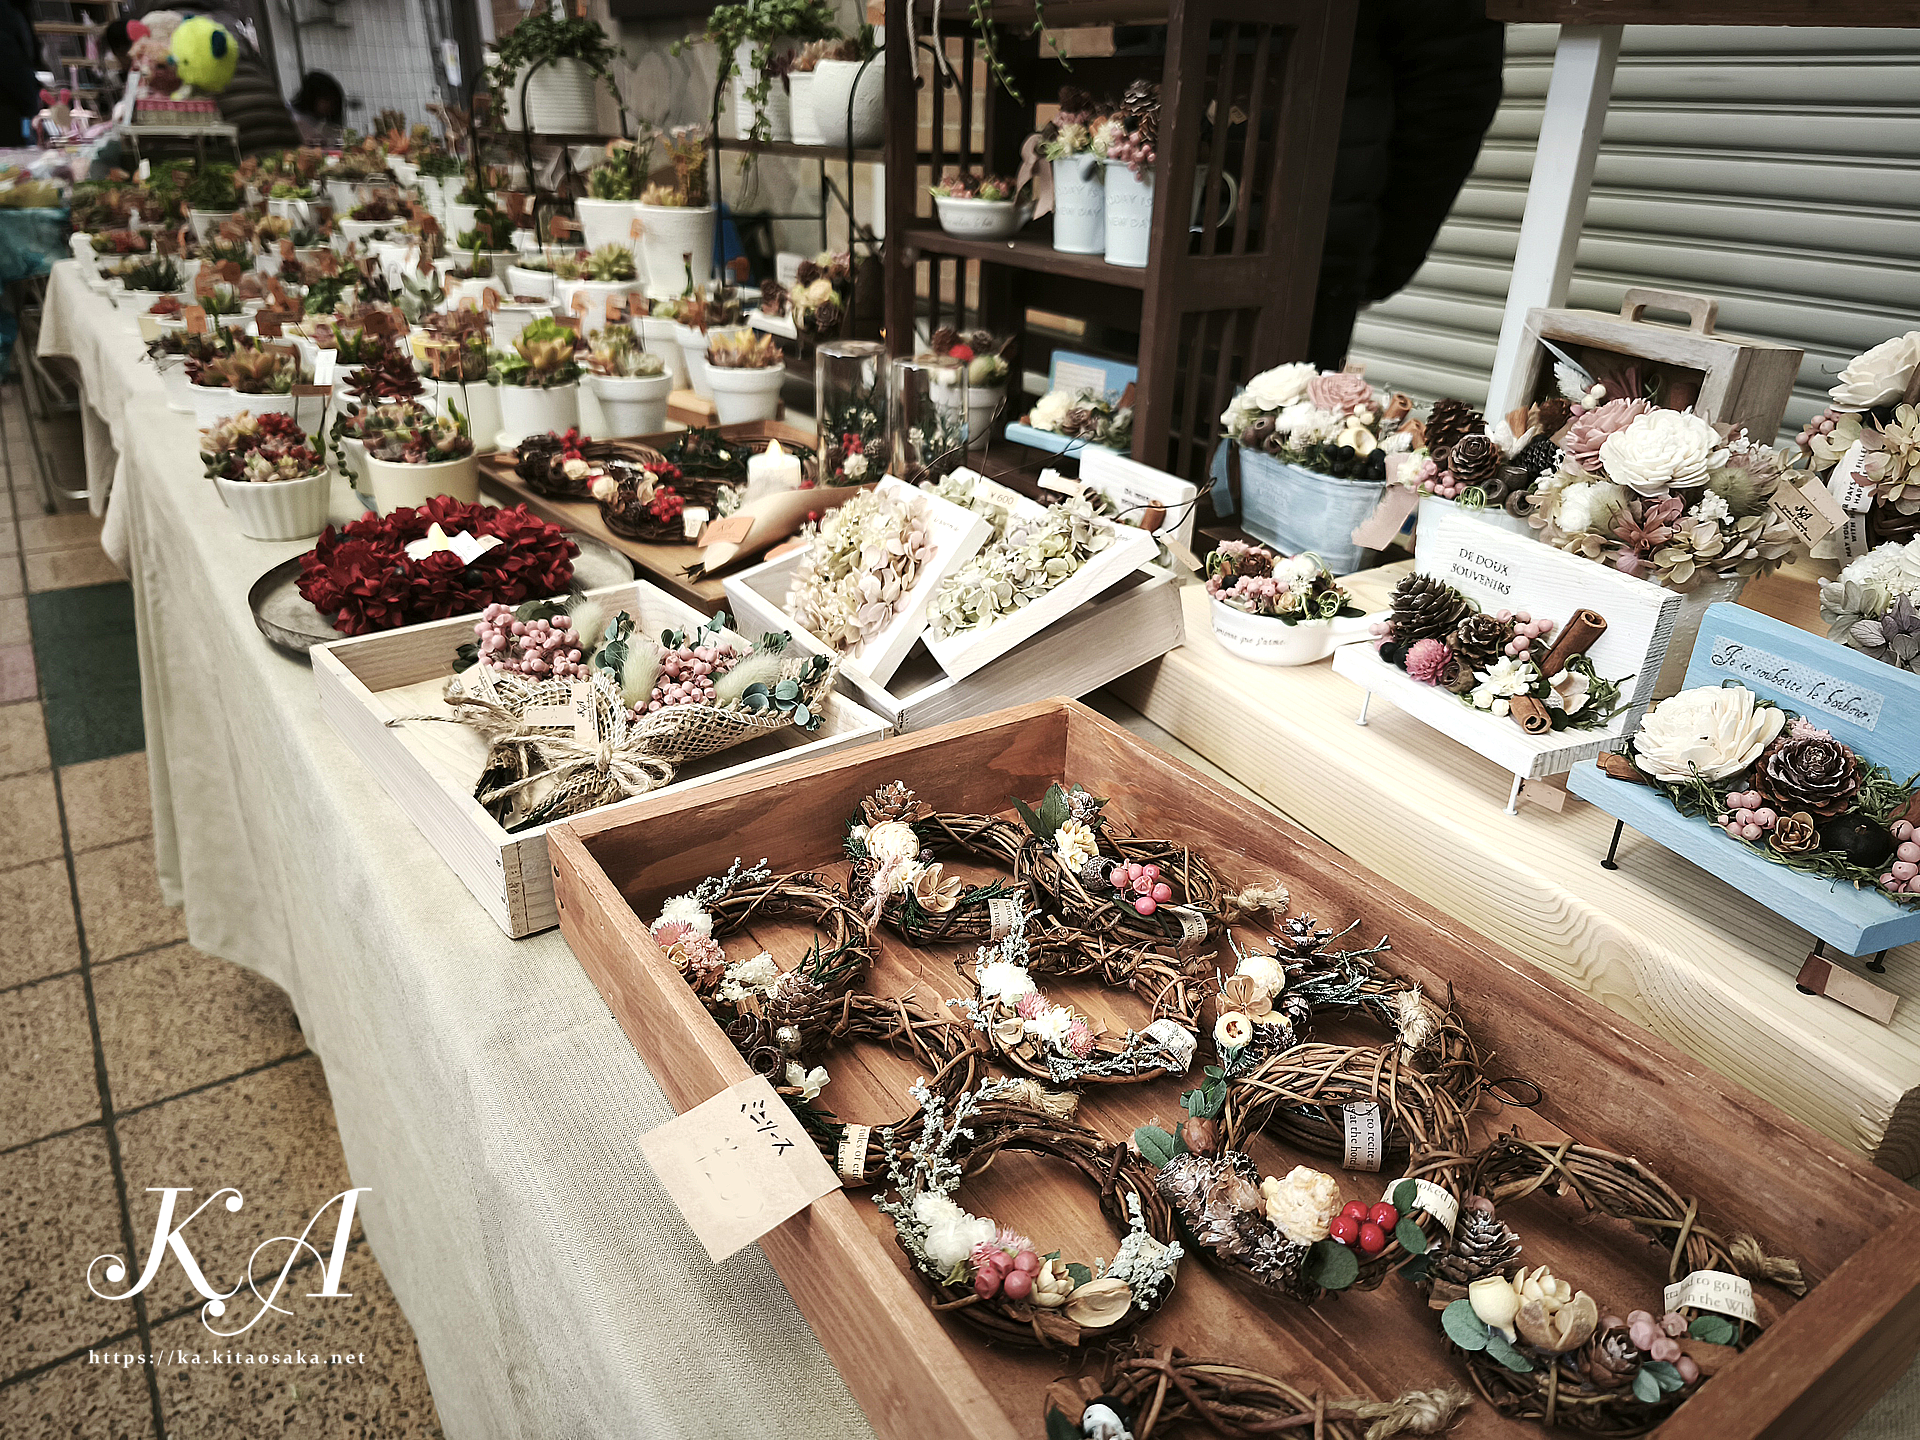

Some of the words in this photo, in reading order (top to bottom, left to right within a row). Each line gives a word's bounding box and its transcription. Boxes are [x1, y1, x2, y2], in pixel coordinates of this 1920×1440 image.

[1850, 522, 1858, 543] WITH
[1459, 548, 1474, 562] DE
[1475, 554, 1509, 577] DOUX
[1450, 562, 1512, 596] SOUVENIRS
[1367, 1118, 1375, 1129] to
[856, 1128, 867, 1149] rules
[1350, 1126, 1361, 1144] the
[1366, 1131, 1378, 1159] recite
[854, 1150, 864, 1161] of
[1696, 1277, 1710, 1286] to
[1713, 1280, 1730, 1292] go
[1699, 1292, 1721, 1307] the
